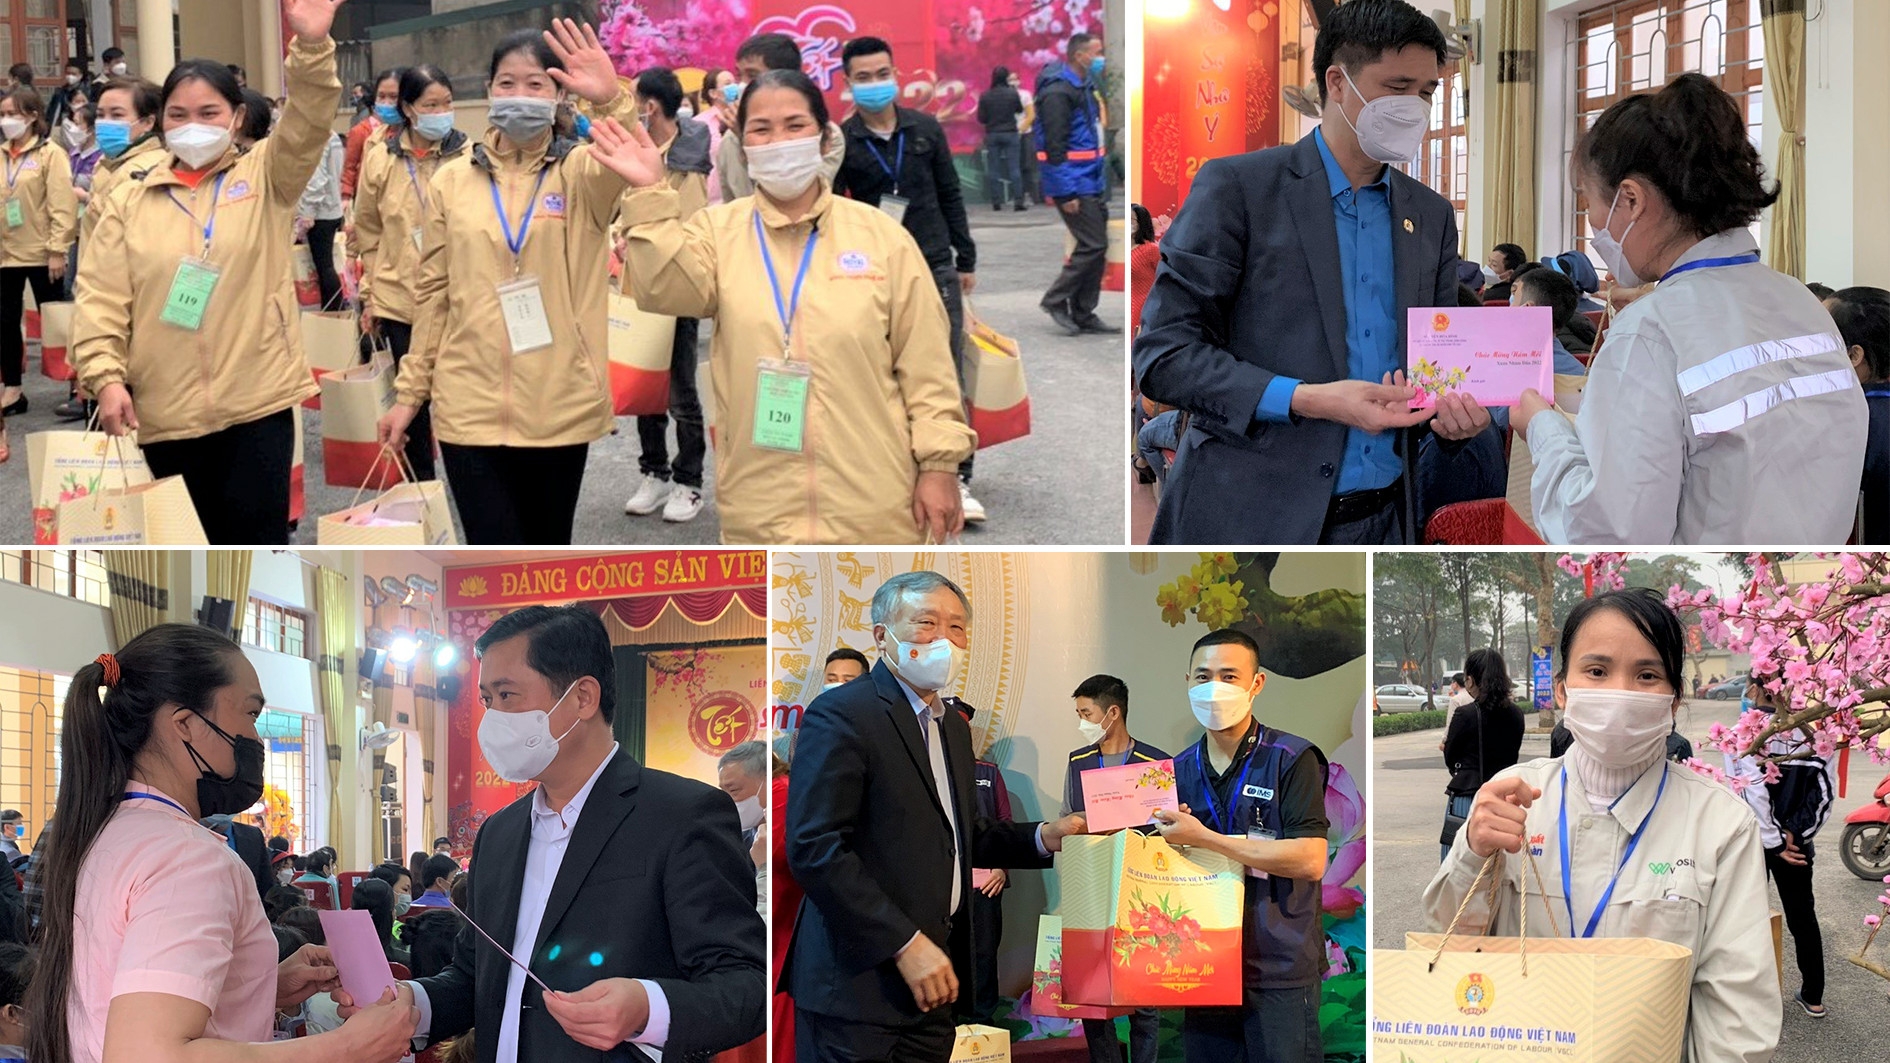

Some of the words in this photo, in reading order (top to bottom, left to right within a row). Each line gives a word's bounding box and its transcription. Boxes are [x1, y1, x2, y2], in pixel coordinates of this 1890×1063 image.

[179, 293, 198, 306] 119
[768, 410, 791, 423] 120
[500, 563, 568, 596] ĐẢNG
[576, 559, 645, 594] CỘNG
[654, 550, 708, 585] SẢN
[700, 704, 747, 747] Tết
[1256, 788, 1272, 798] IMS
[1395, 1020, 1422, 1034] LIÊN
[1426, 1022, 1459, 1036] ĐOÀN
[1462, 1025, 1485, 1038] LAO
[1490, 1025, 1522, 1042] ĐỘNG
[1527, 1027, 1552, 1044] VIỆT
[1555, 1030, 1576, 1044] NAM
[1398, 1038, 1435, 1047] GENERAL
[1437, 1040, 1505, 1050] CONFEDERATION
[1520, 1044, 1553, 1053] LABOUR
